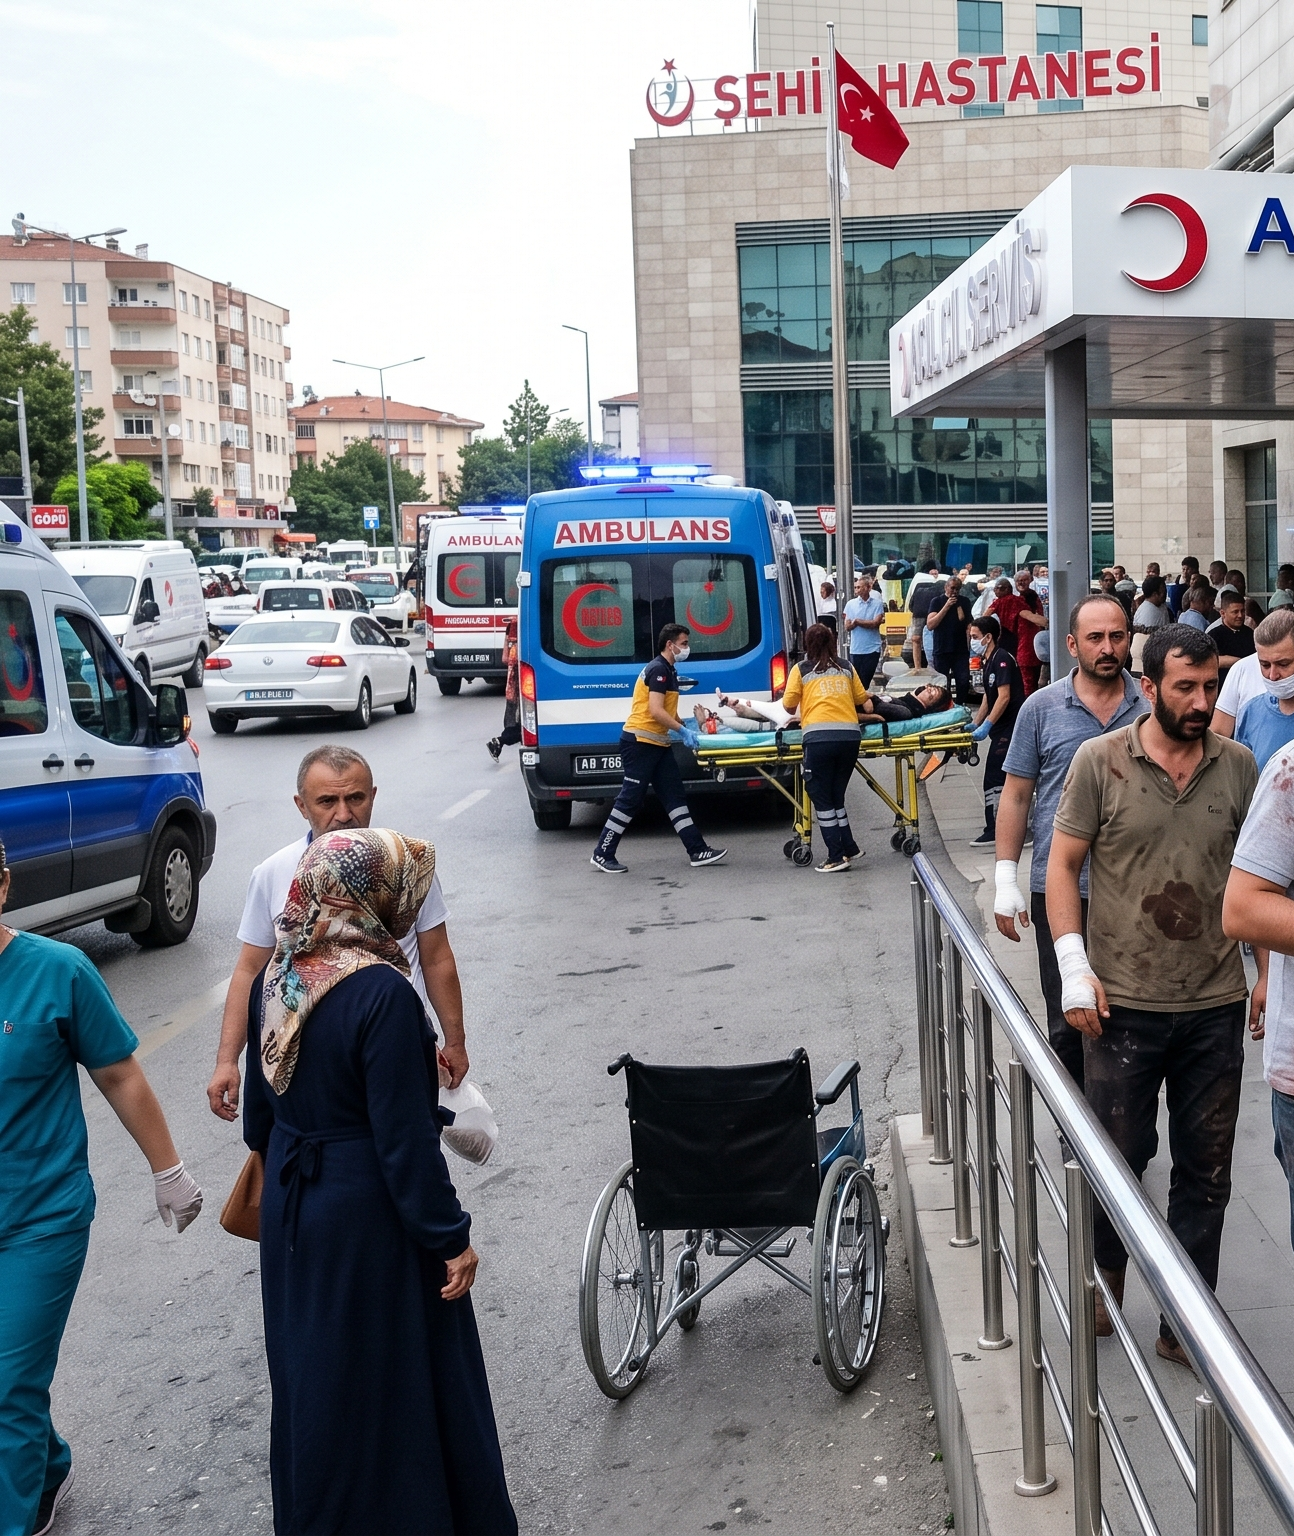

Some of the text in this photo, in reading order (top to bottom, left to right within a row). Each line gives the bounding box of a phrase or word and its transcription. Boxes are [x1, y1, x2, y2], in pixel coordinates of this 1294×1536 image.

[714, 31, 1161, 127] ŞEHİ HASTANESİ
[447, 535, 523, 547] AMBULAN
[556, 520, 731, 544] AMBULANS
[581, 757, 597, 770] AB
